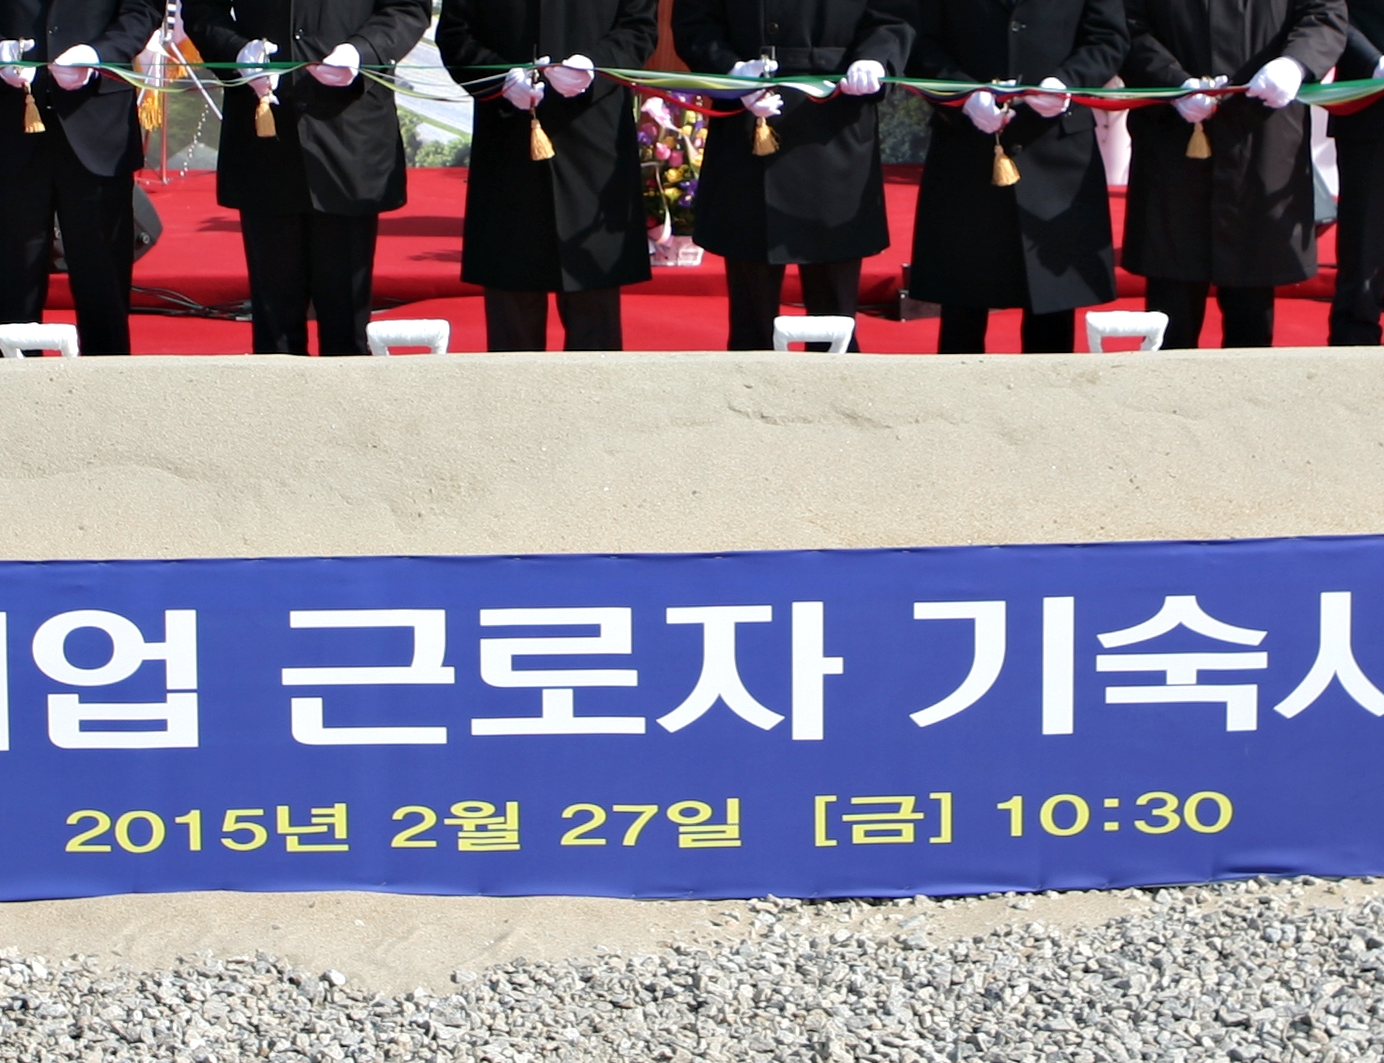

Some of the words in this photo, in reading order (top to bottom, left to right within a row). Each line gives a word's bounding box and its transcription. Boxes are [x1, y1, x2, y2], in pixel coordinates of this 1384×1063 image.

[280, 600, 845, 747] 근로자
[64, 802, 350, 855] 2015년
[390, 800, 521, 853] 2월
[560, 797, 743, 849] 27일
[814, 791, 953, 848] [금]
[997, 790, 1234, 838] 10:30
